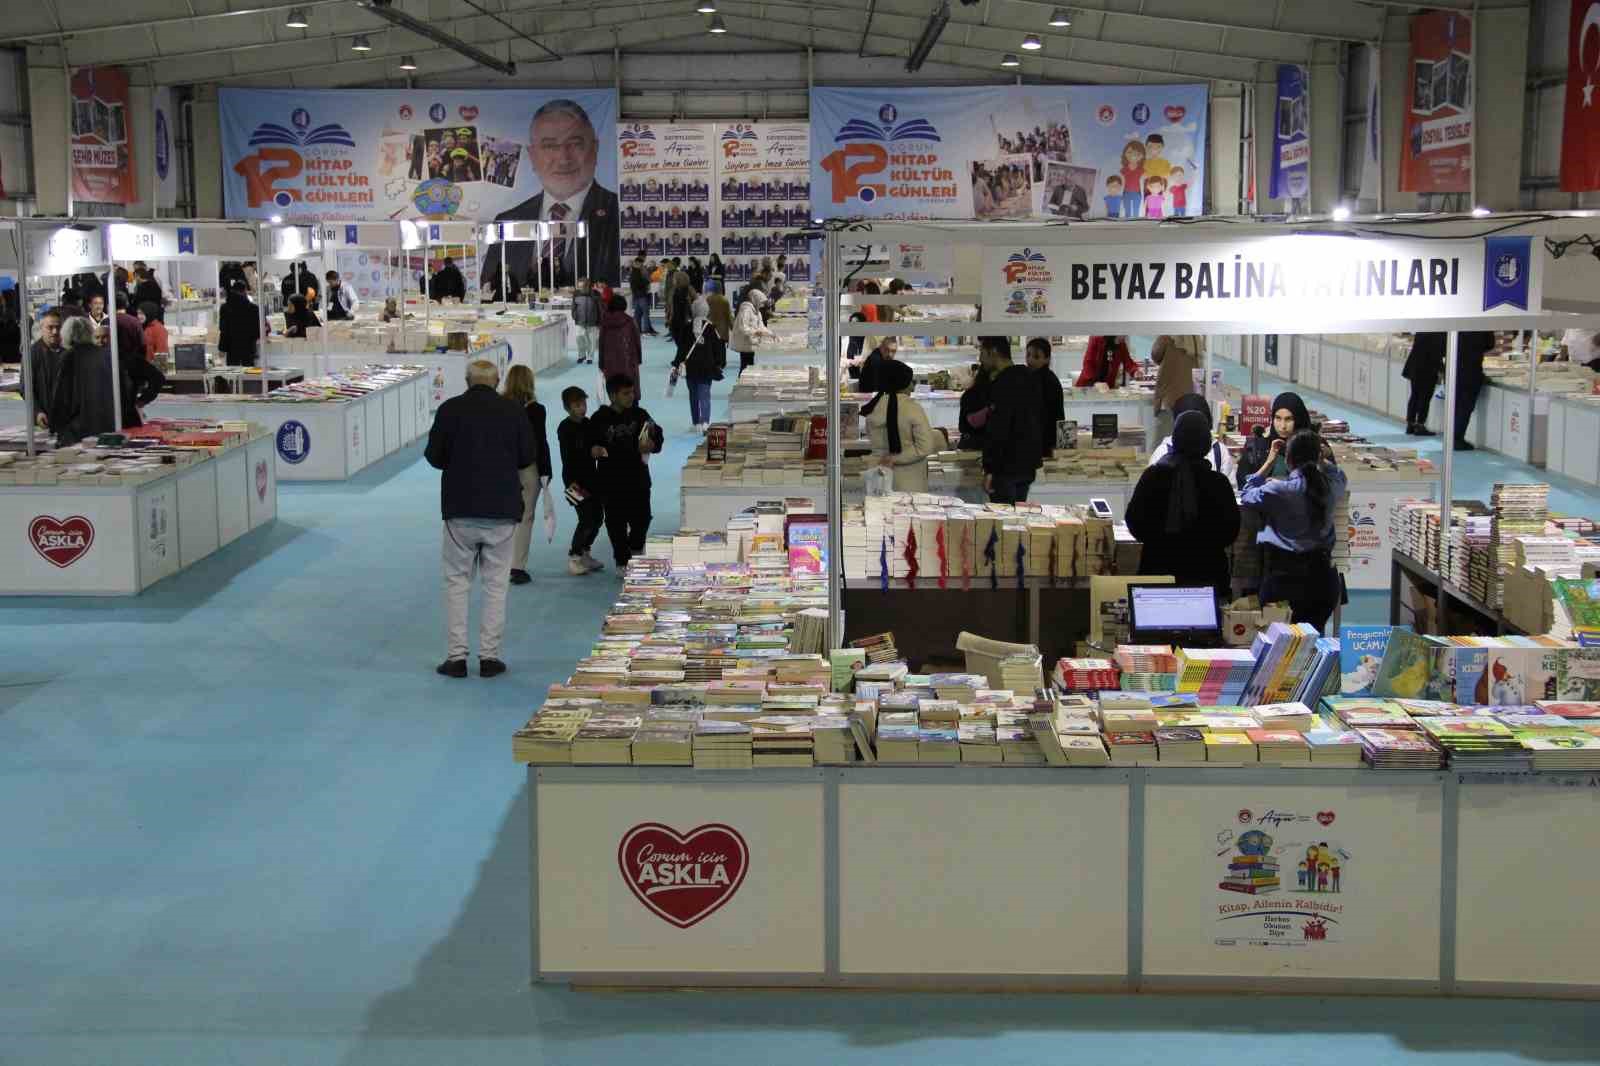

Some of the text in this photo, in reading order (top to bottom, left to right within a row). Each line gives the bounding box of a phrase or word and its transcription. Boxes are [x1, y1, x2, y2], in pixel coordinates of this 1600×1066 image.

[305, 157, 353, 171] KİTAP
[889, 153, 937, 166] KİTAP
[305, 173, 370, 187] KÜLTÜR
[890, 168, 953, 181] KÜLTÜR
[305, 189, 375, 203] GÜNLERİ
[889, 184, 957, 198] GÜNLERİ
[1071, 263, 1166, 300] BEYAZ
[1174, 254, 1287, 299] BALİNA
